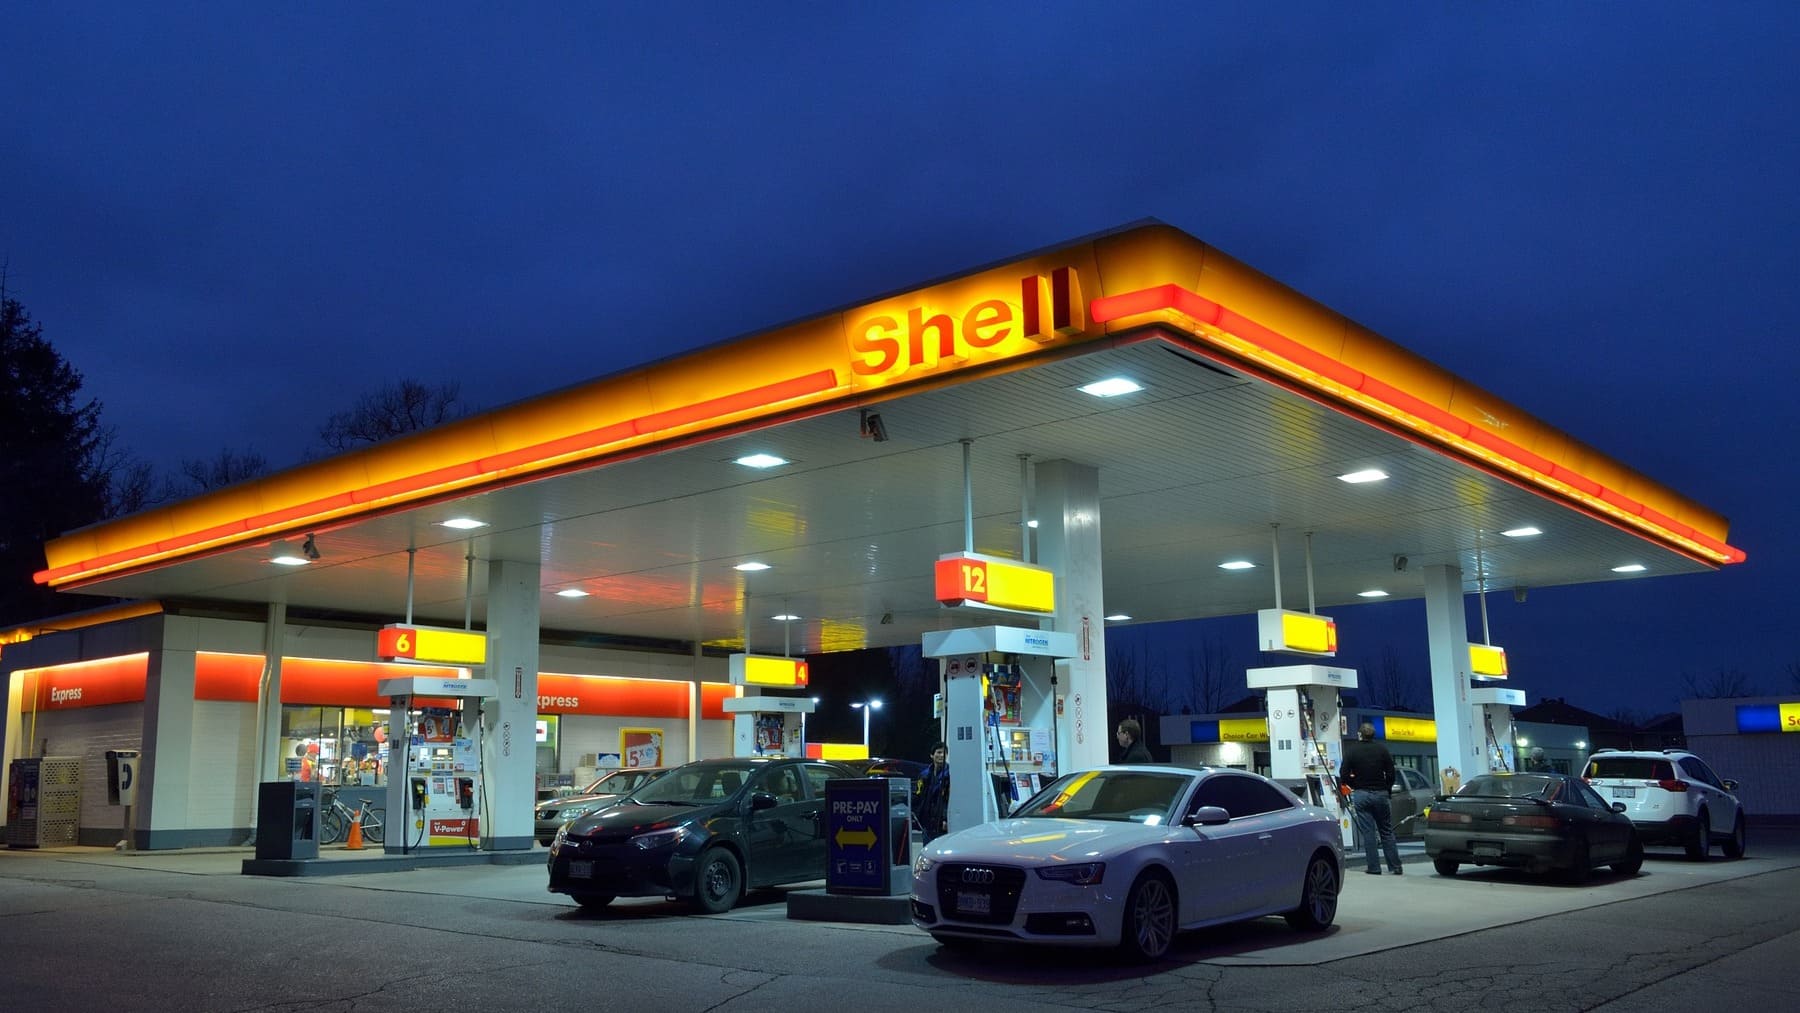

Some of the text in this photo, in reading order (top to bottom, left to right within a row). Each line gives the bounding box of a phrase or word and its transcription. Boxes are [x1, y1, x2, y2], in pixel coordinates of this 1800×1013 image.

[851, 266, 1085, 376] Shell
[962, 565, 986, 593] 12
[396, 633, 410, 653] 6
[798, 666, 806, 681] 4
[52, 686, 82, 704] Express
[833, 801, 879, 814] PRE-PAY
[847, 815, 863, 823] ONLY
[434, 825, 465, 833] V-Power
